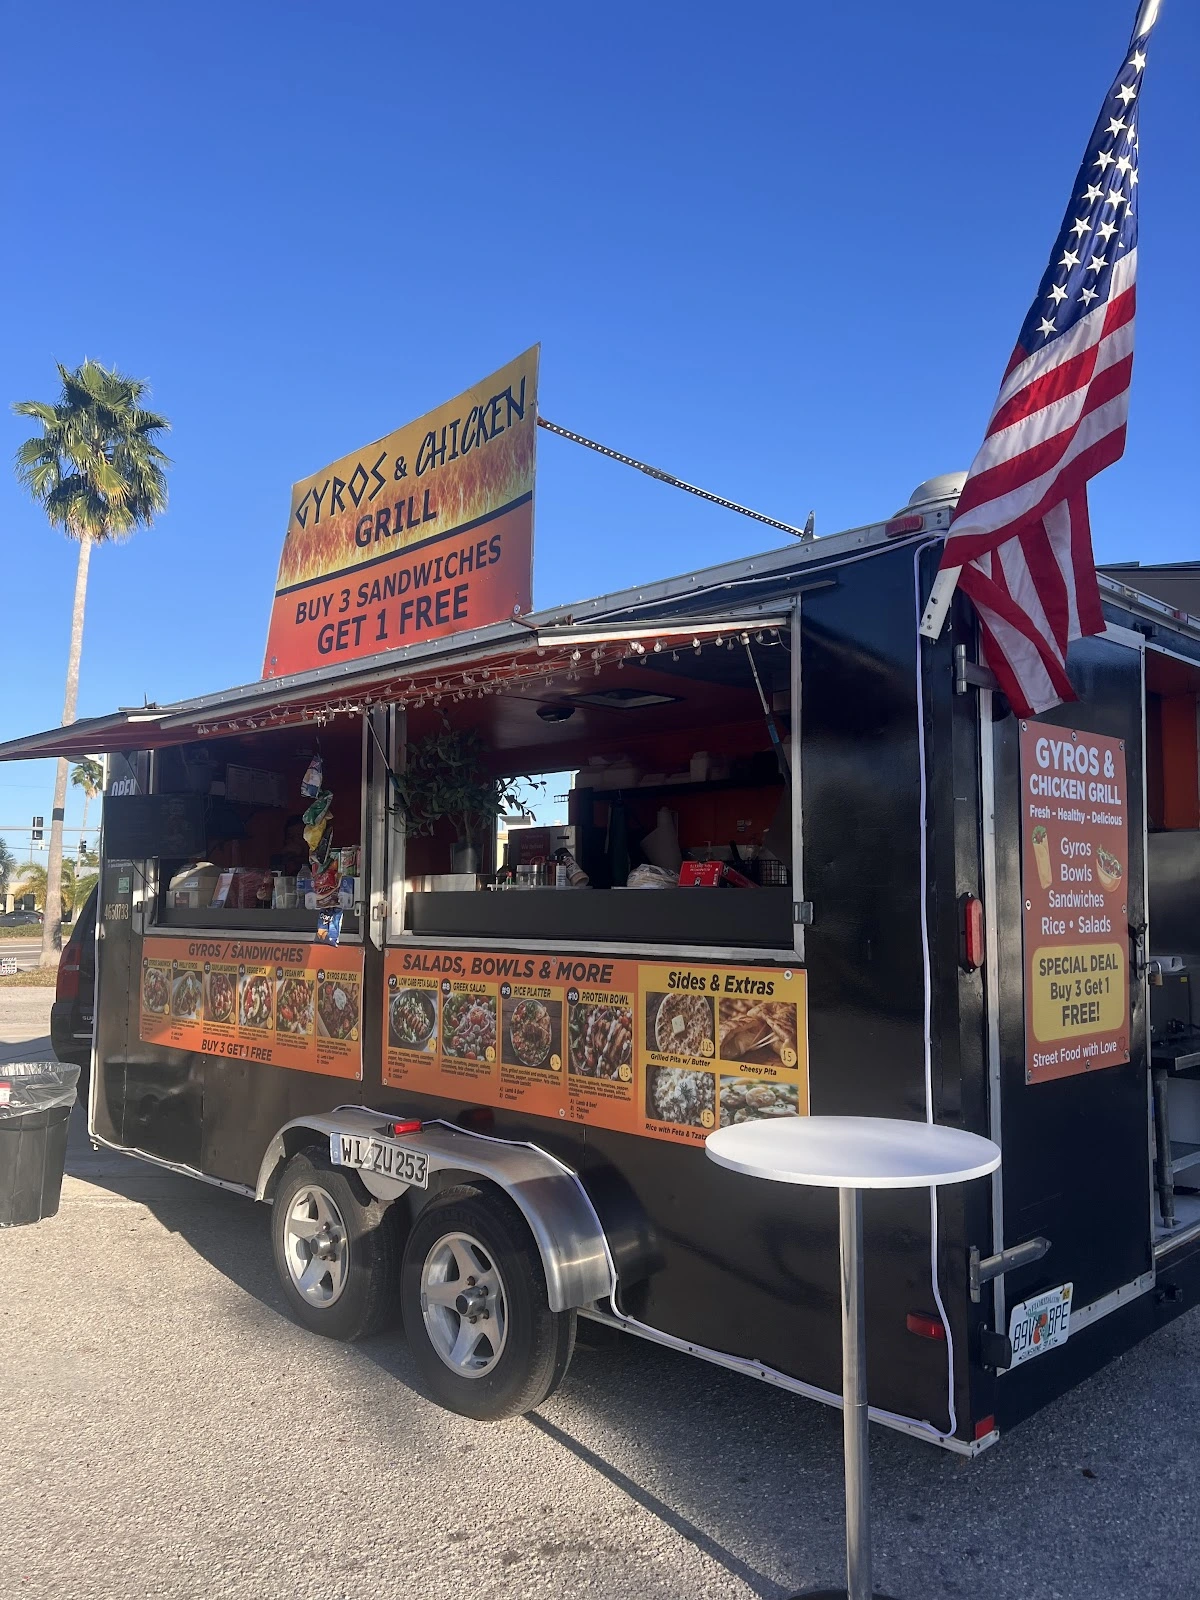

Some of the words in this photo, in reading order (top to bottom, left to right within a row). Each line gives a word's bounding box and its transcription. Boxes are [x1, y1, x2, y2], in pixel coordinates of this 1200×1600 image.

[295, 451, 388, 529] GYROS
[393, 456, 408, 481] &
[415, 376, 526, 477] CHICKEN
[354, 488, 437, 548] GRILL
[295, 593, 334, 625] BUY
[338, 589, 351, 613] 3
[356, 534, 501, 608] SANDWICHES
[317, 614, 367, 655] GET
[375, 608, 388, 641] 1
[399, 583, 469, 635] FREE
[1035, 737, 1100, 777] GYROS
[1103, 750, 1115, 779] &
[1029, 774, 1086, 801] CHICKEN
[1088, 781, 1122, 805] GRILL
[1030, 804, 1050, 820] Fresh
[1058, 807, 1086, 824] Healthy
[1092, 810, 1122, 826] Delicious
[1060, 837, 1092, 858] Gyros
[1061, 863, 1092, 883] Bowls
[1048, 889, 1105, 909] Sandwiches
[1041, 915, 1066, 935] Rice
[1078, 915, 1112, 935] Salads
[188, 942, 221, 958] GYROS
[231, 945, 304, 963] SANDWICHES
[403, 954, 466, 977] SALADS,
[471, 957, 535, 979] BOWLS
[539, 960, 551, 979] &
[556, 961, 614, 984] MORE
[1039, 955, 1088, 977] SPECIAL
[1090, 953, 1119, 972] DEAL
[398, 978, 408, 986] LOW
[408, 978, 416, 986] CARB
[418, 979, 426, 988] FETA
[426, 980, 438, 988] SALAD
[453, 982, 468, 992] GREEK
[470, 984, 486, 992] SALAD
[502, 986, 510, 994] #9
[514, 986, 526, 996] RICE
[526, 987, 551, 998] PLATTER
[668, 971, 707, 990] Sides
[710, 974, 721, 992] &
[724, 975, 775, 996] Extras
[1050, 980, 1073, 1004] Buy
[1075, 980, 1082, 998] 3
[1084, 977, 1103, 997] Get
[1105, 976, 1110, 995] 1
[568, 992, 578, 1000] #10
[582, 992, 608, 1002] PROTEIN
[610, 995, 629, 1004] BOWL
[1062, 1001, 1100, 1027] FREE!
[201, 1039, 218, 1052] BUY
[220, 1042, 226, 1054] 3
[227, 1042, 244, 1057] GET
[245, 1045, 249, 1056] 1
[250, 1046, 272, 1062] FREE
[651, 1054, 668, 1062] Grilled
[1033, 1049, 1058, 1068] Street
[1060, 1046, 1081, 1064] Food
[1082, 1043, 1099, 1059] with
[1100, 1040, 1117, 1056] Love
[740, 1064, 762, 1076] Cheesy
[764, 1067, 776, 1076] Pita
[645, 1124, 657, 1132] Rice
[672, 1129, 684, 1137] Feta
[692, 1132, 708, 1140] Tzatz
[341, 1138, 363, 1165] WI
[396, 1151, 426, 1183] 253
